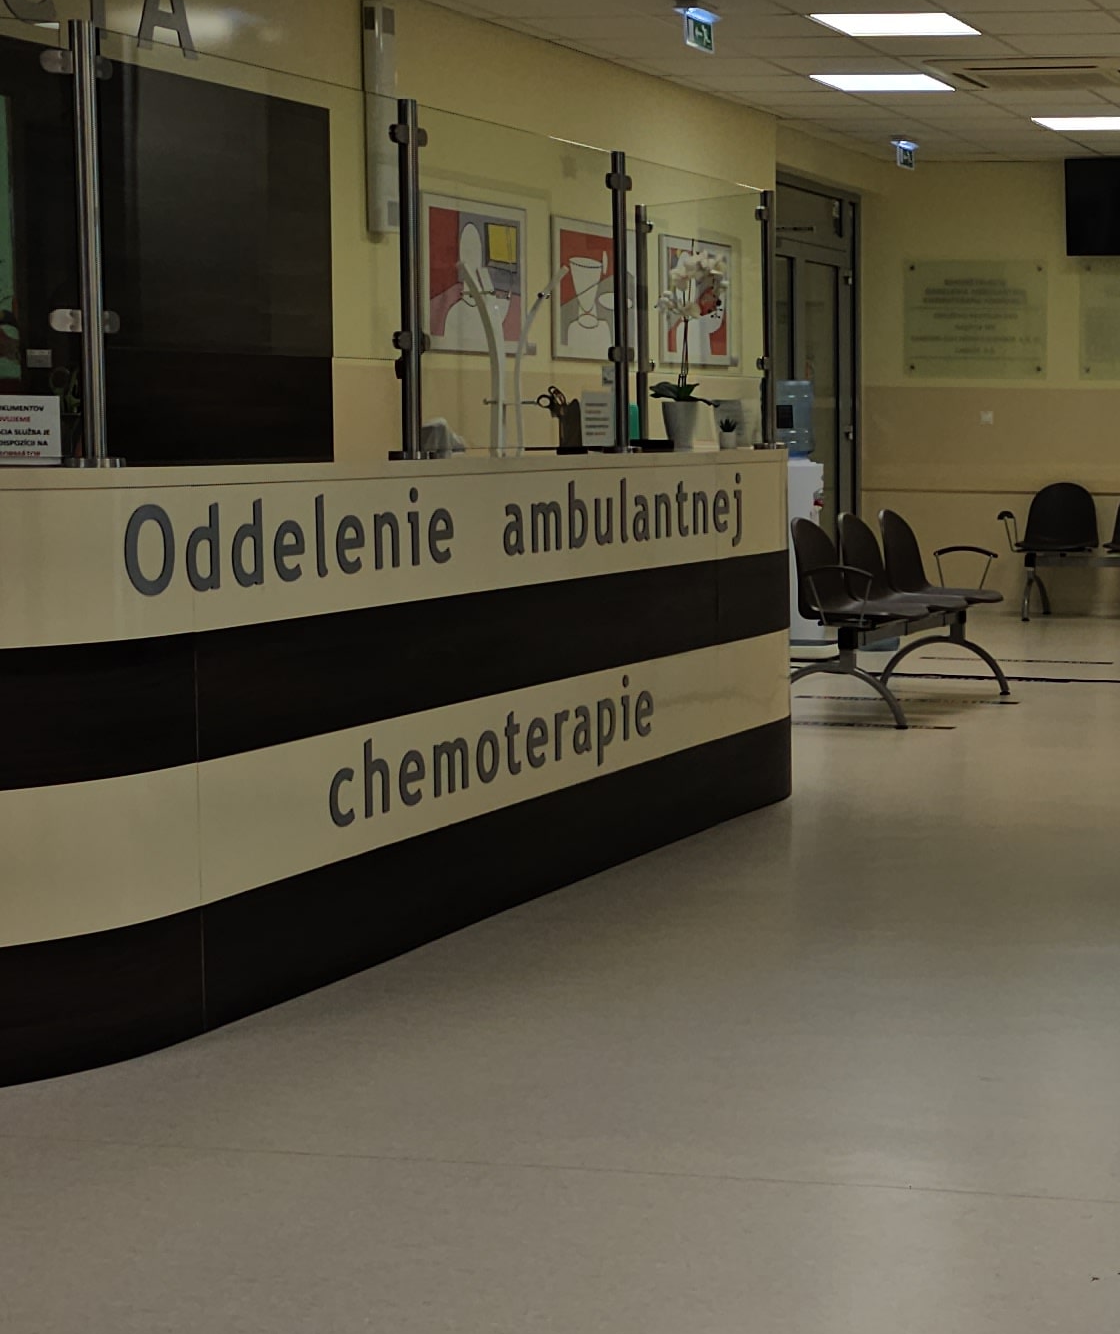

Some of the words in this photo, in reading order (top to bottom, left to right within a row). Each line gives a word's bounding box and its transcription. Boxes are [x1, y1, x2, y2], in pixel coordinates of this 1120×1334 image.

[124, 487, 455, 597] Oddelenie
[503, 473, 744, 557] ambulantnej
[329, 675, 654, 829] chemoterapie
